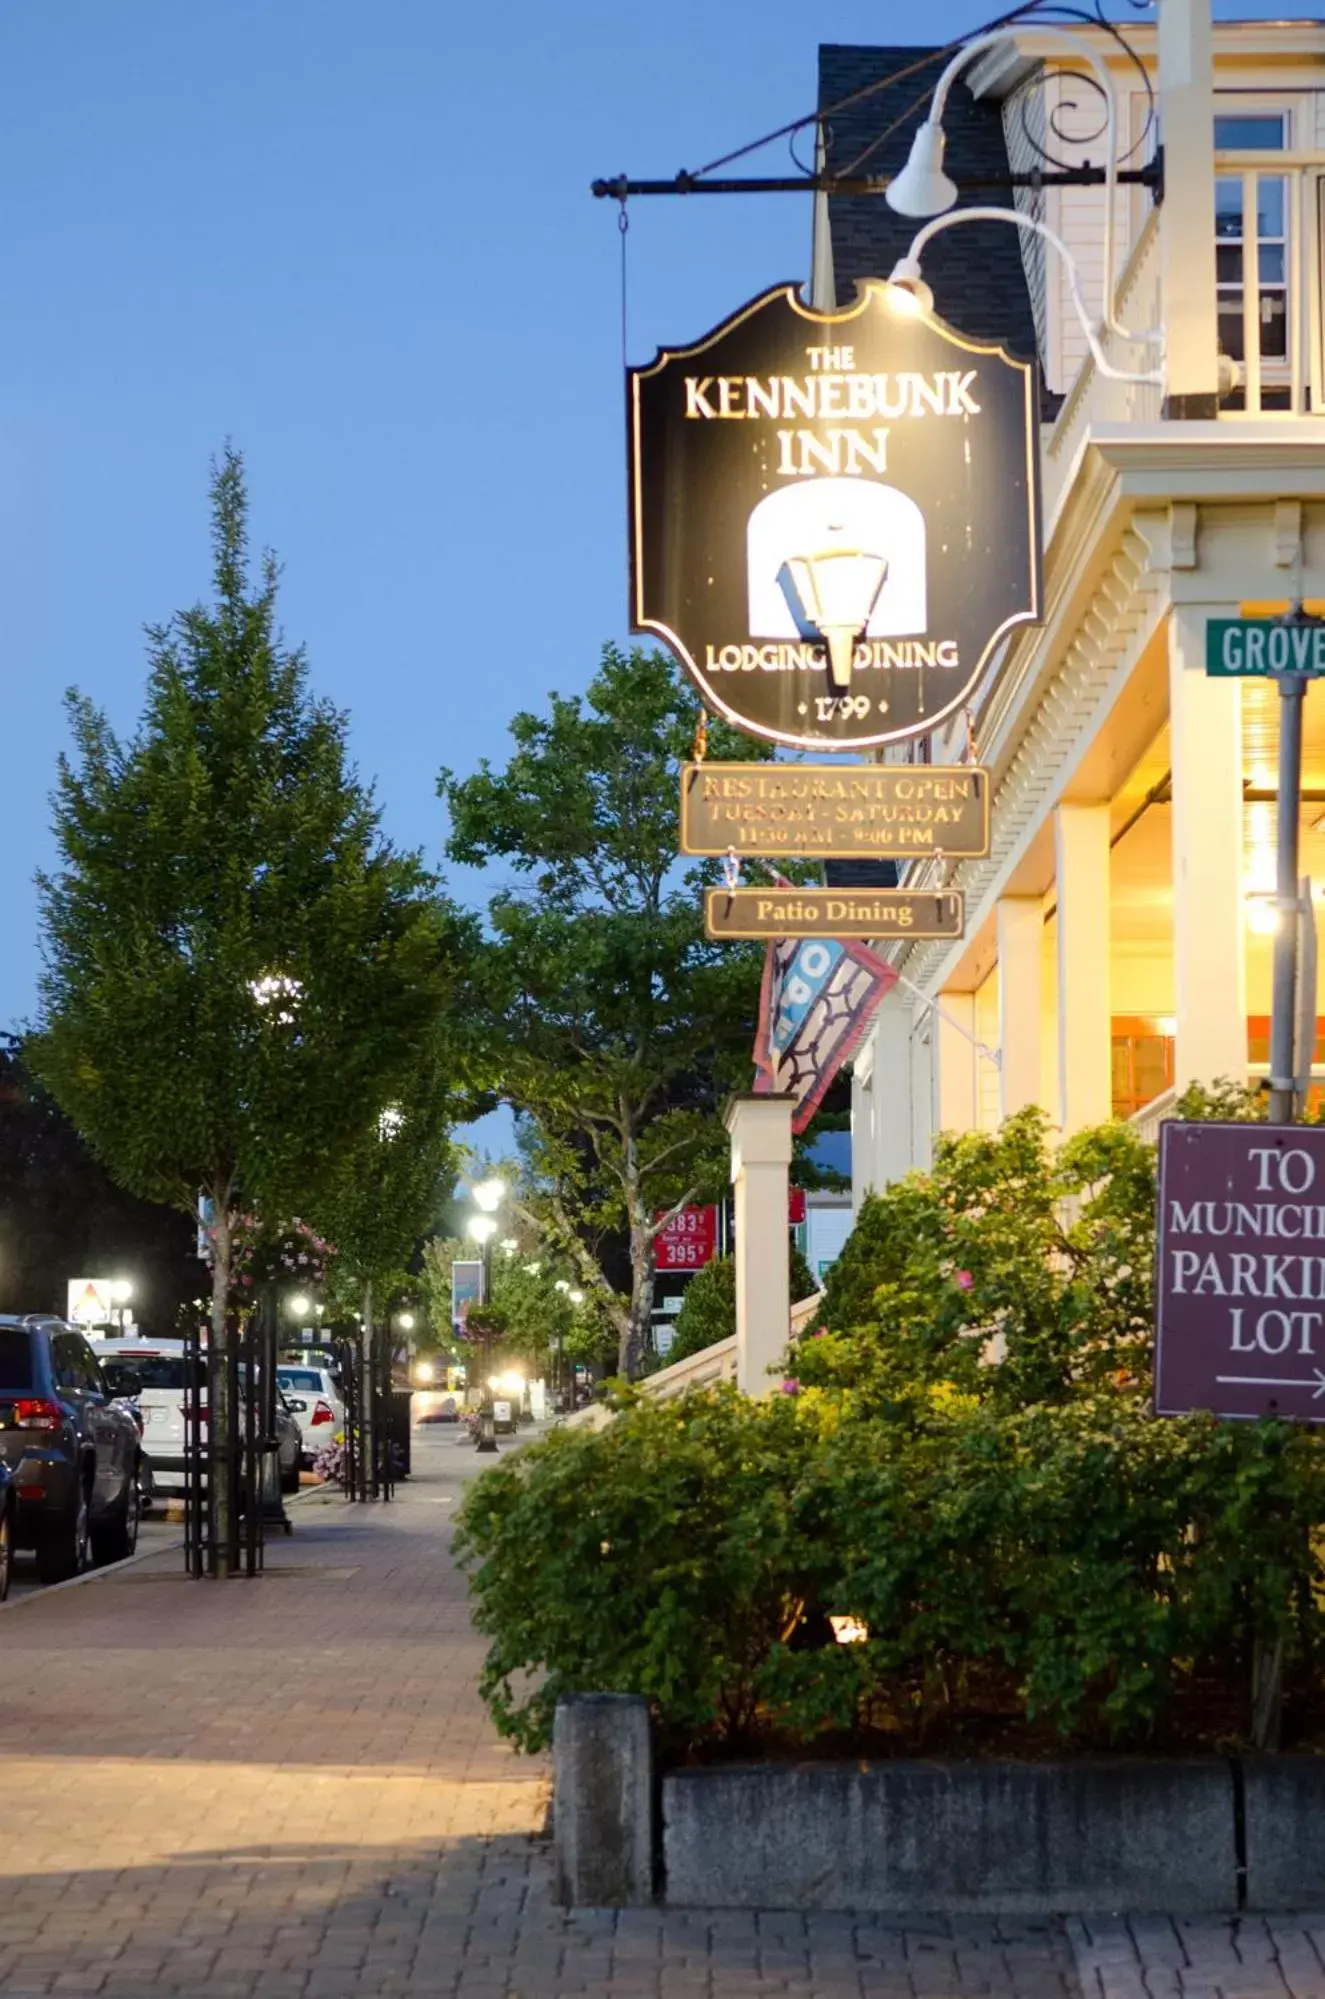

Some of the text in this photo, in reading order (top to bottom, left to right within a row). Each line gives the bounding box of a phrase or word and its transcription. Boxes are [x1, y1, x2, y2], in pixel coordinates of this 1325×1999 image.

[806, 346, 855, 371] THE
[684, 370, 981, 419] KENNEBUNK
[776, 428, 890, 475] INN
[706, 641, 958, 672] LODGING DINING
[1222, 627, 1325, 671] GROVE
[815, 696, 870, 721] 1799
[702, 776, 970, 800] RESTAURANT OPEN
[710, 803, 816, 821] TUESDAY
[835, 803, 965, 822] SATURDAY
[898, 827, 934, 844] PM
[756, 900, 914, 927] Patio Dining
[1248, 1149, 1316, 1194] TO
[666, 1245, 697, 1263] 395
[1229, 1308, 1322, 1355] LOT
